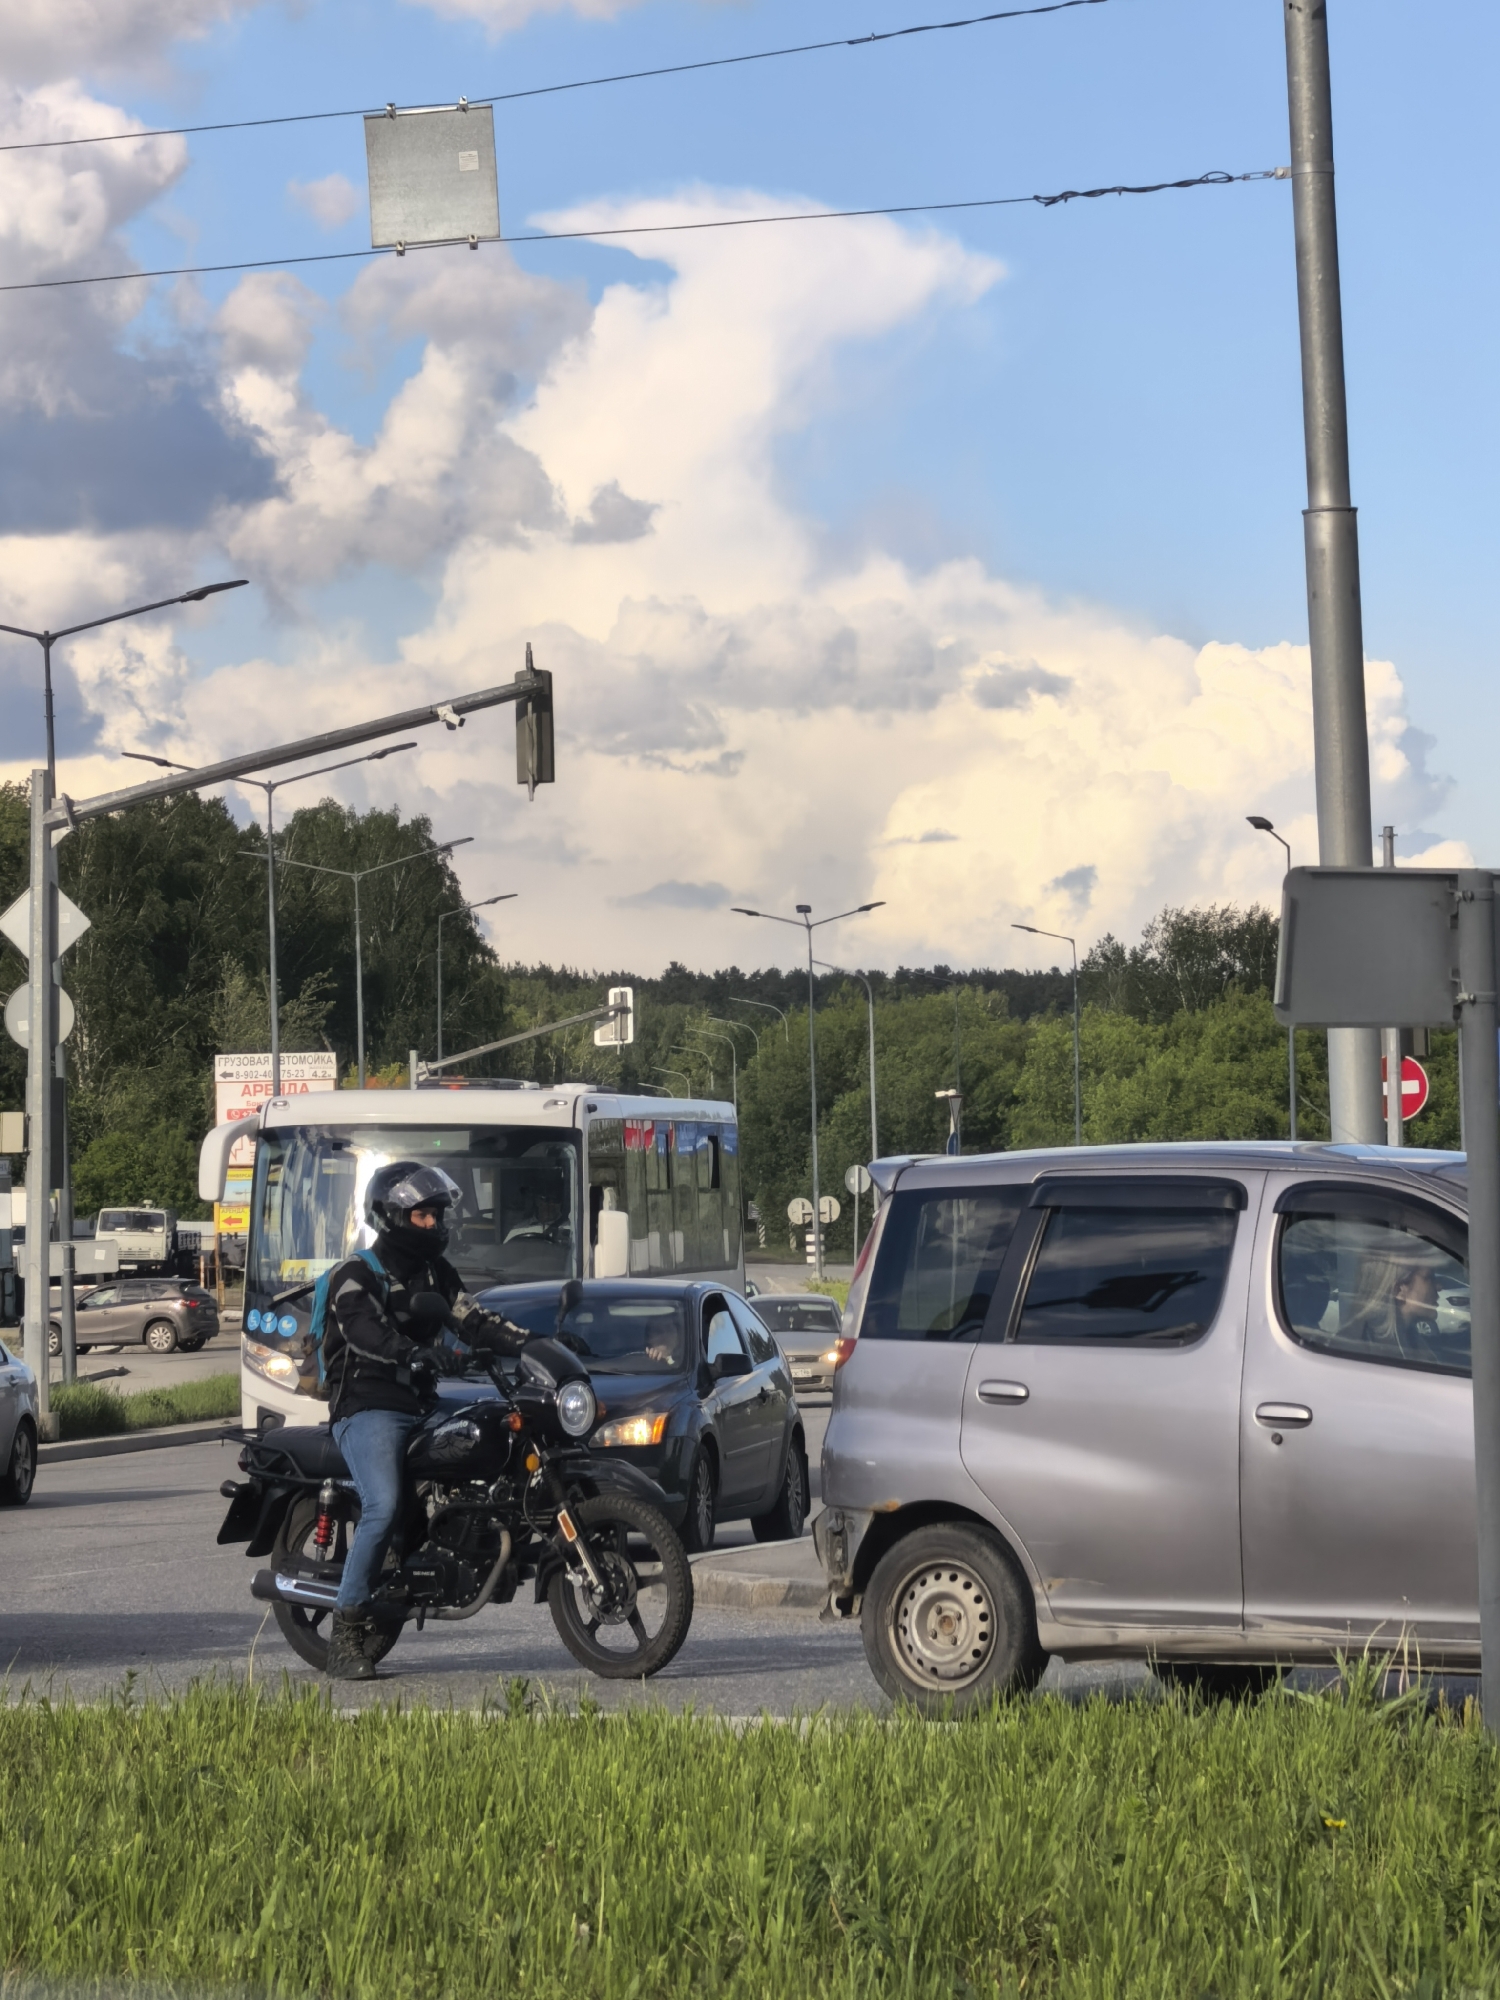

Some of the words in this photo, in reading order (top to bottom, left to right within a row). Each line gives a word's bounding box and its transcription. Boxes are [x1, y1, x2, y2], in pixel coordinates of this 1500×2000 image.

[218, 1056, 270, 1067] ГРУЗОВАЯ
[273, 1054, 333, 1066] ВТОМОЙКА
[235, 1069, 305, 1080] 8-902-4075-23
